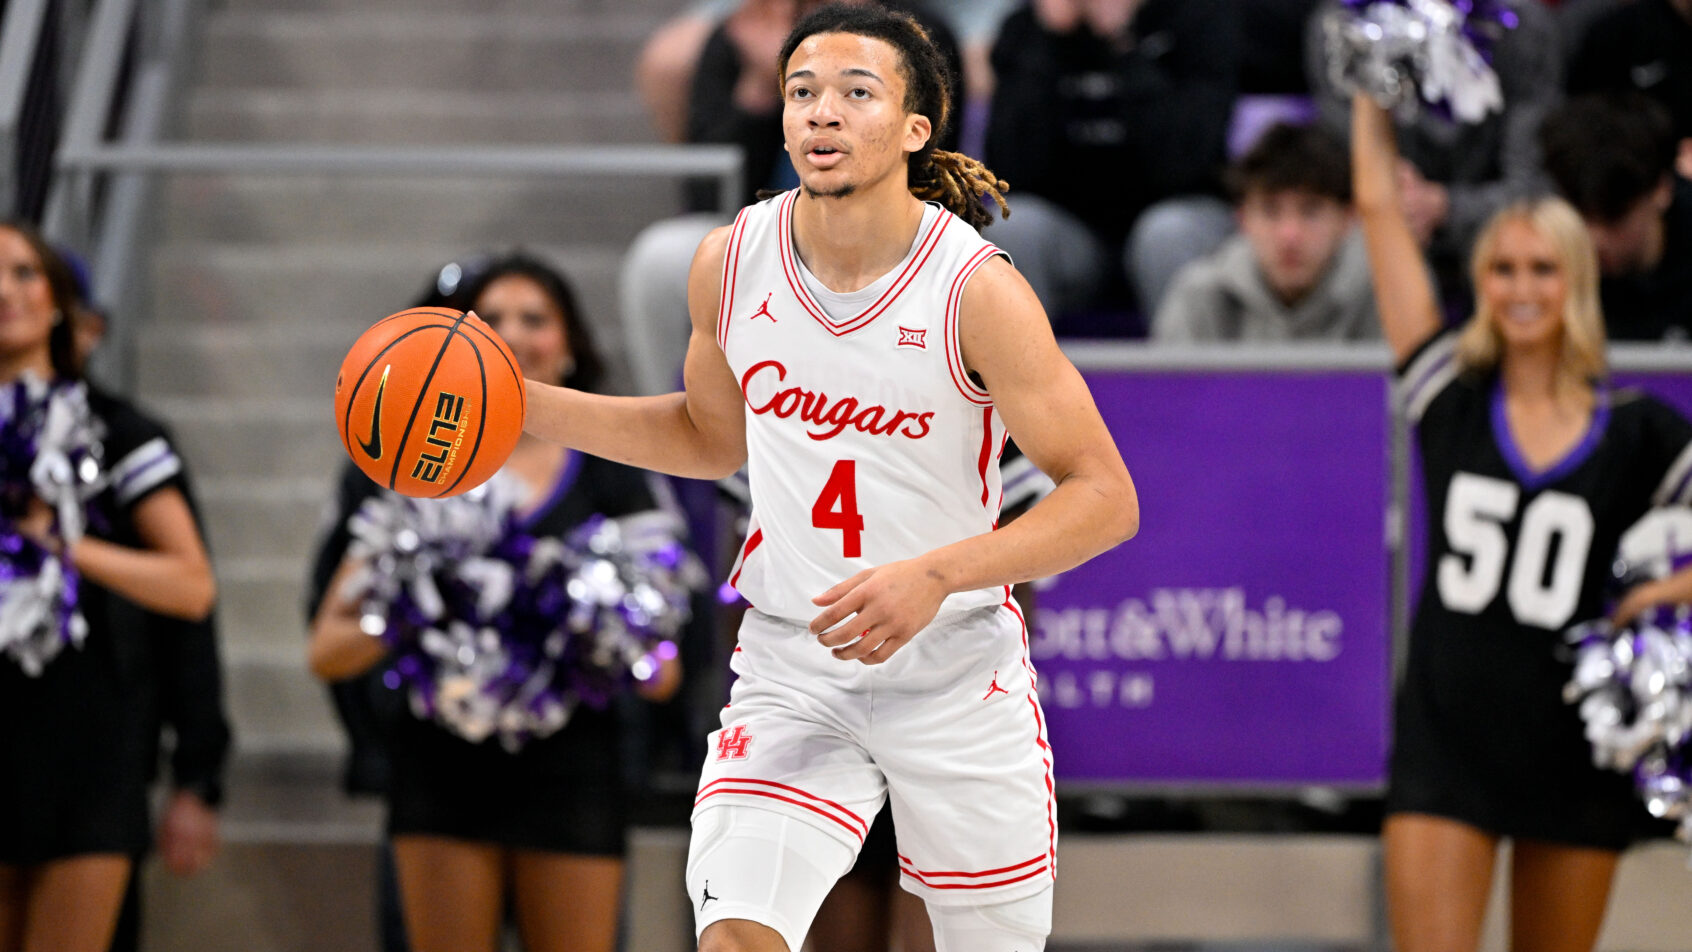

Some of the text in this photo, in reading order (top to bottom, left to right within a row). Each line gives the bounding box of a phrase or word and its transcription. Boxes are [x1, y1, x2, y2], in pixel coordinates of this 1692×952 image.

[411, 391, 465, 483] ELITE
[741, 360, 936, 441] Cougars
[811, 459, 865, 558] 4
[1436, 470, 1596, 631] 50
